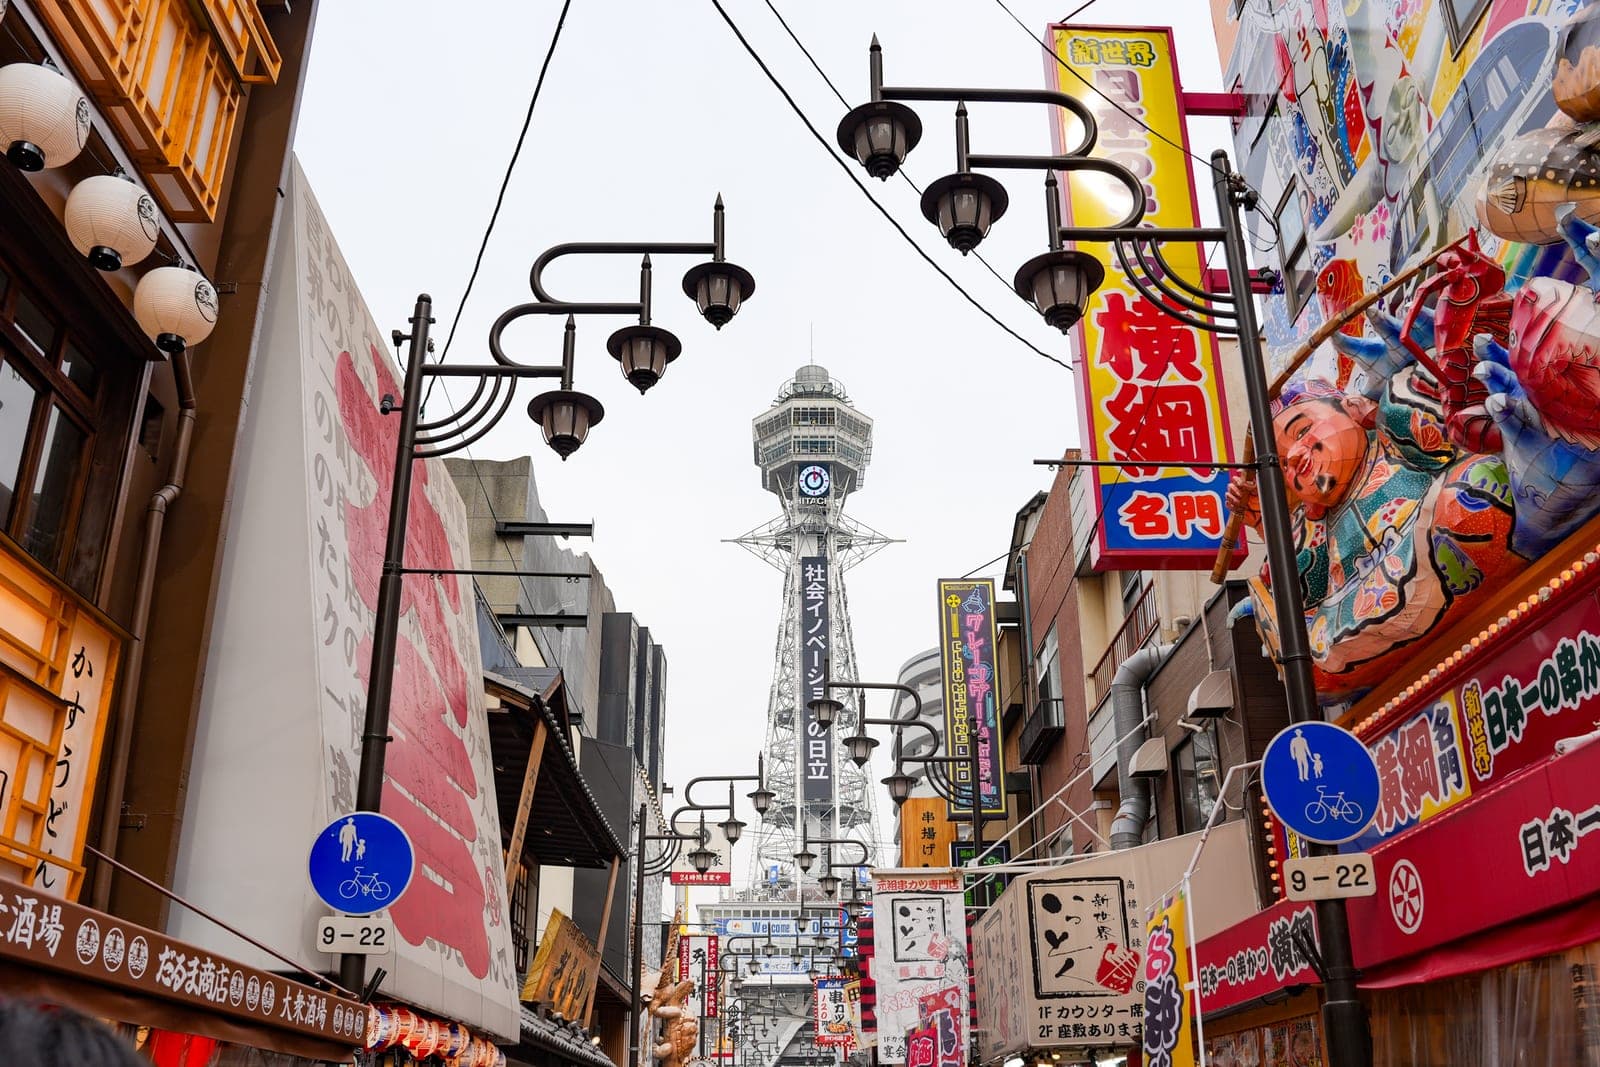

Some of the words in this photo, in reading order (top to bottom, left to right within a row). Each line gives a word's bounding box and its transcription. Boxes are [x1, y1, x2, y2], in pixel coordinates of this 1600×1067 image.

[1070, 37, 1156, 67] 新世界
[1096, 292, 1216, 479] 横綱
[1120, 491, 1223, 538] 名門
[804, 563, 829, 780] 社会イノベーショの日立
[1433, 705, 1463, 798] 名門
[1463, 682, 1492, 778] 新世界
[35, 646, 94, 889] かすうどん
[920, 811, 937, 867] 串揚げ
[1521, 810, 1600, 872] 日本一
[876, 879, 960, 891] 元祖串カツ専門店
[752, 921, 789, 932] Wecome
[1091, 892, 1117, 941] 新世界
[1199, 947, 1268, 996] 日本一の串かつ
[1268, 907, 1318, 981] 横綱
[156, 943, 231, 1004] だるま商店
[279, 986, 328, 1031] 大衆酒場
[829, 989, 845, 1023] 串カツ
[1038, 1006, 1052, 1019] 1F
[1057, 1003, 1143, 1019] カウンター席
[1038, 1024, 1054, 1038] 2F
[1058, 1022, 1143, 1039] 座敷あります
